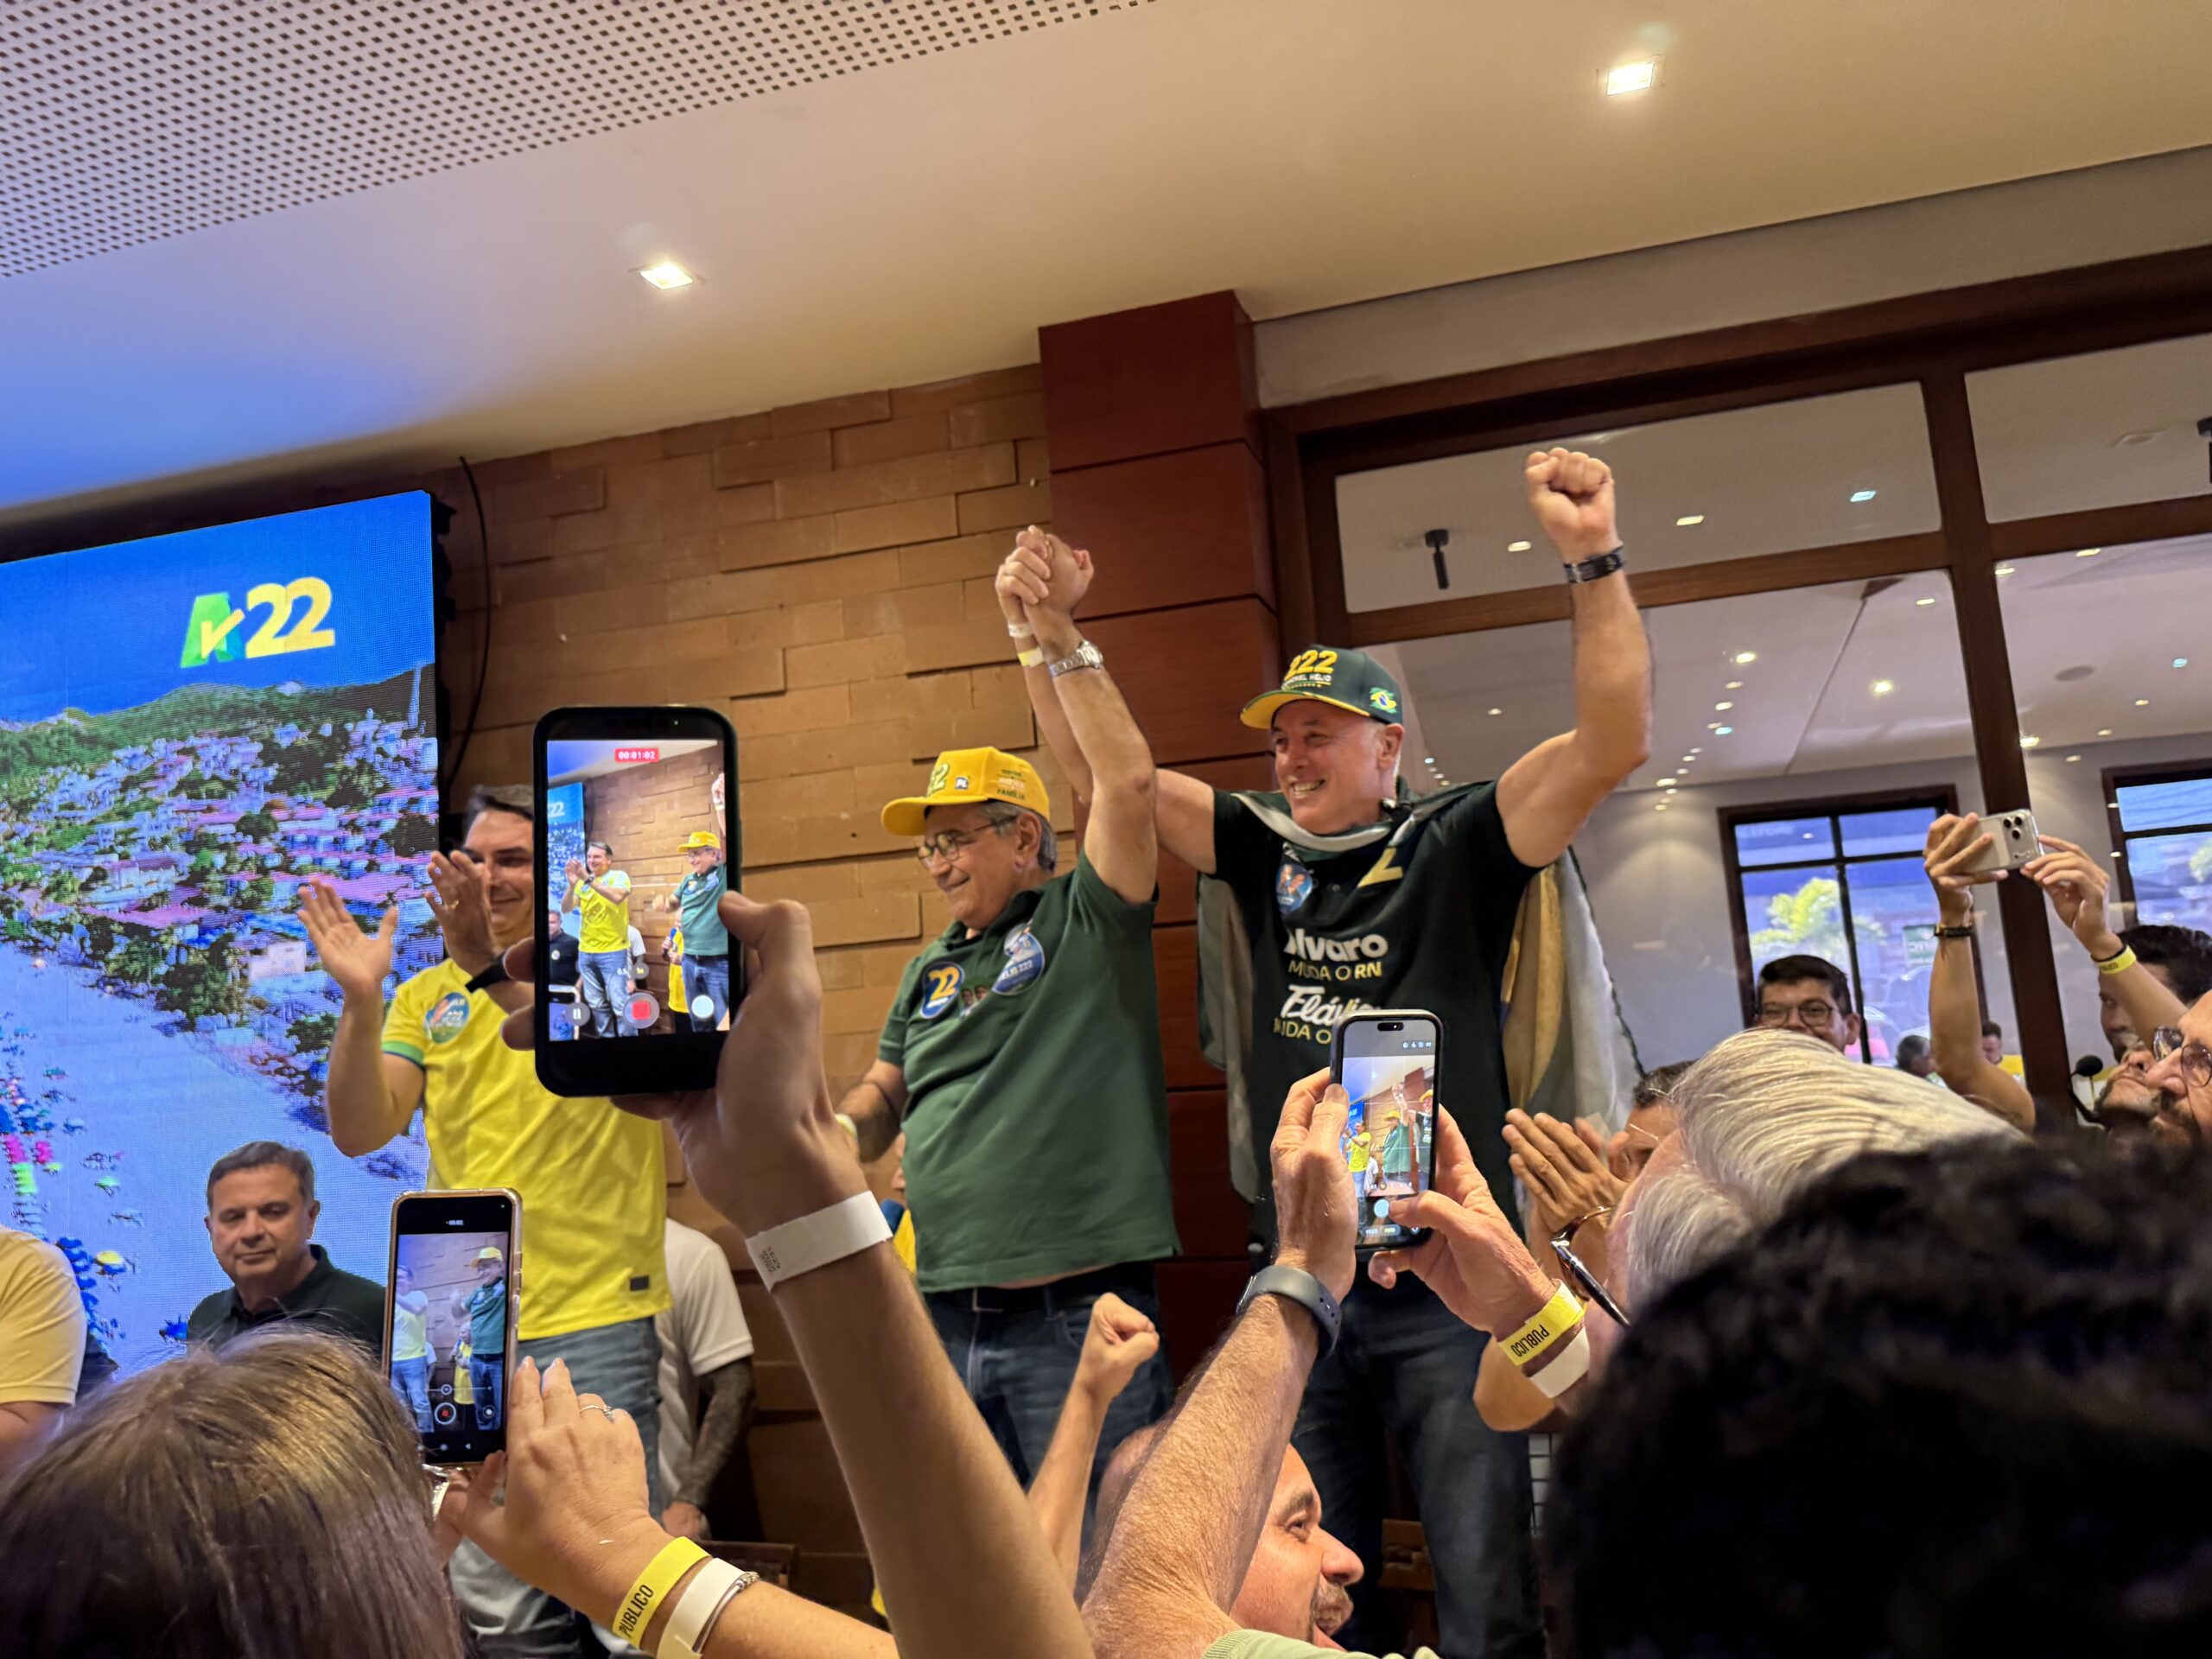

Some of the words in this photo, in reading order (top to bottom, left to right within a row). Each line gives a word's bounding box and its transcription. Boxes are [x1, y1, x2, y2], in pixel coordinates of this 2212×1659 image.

[618, 751, 656, 760] 00:01:02
[1335, 965, 1351, 981] O
[1354, 961, 1382, 980] RN
[1281, 984, 1382, 1026] Fláv
[1315, 1029, 1332, 1045] O
